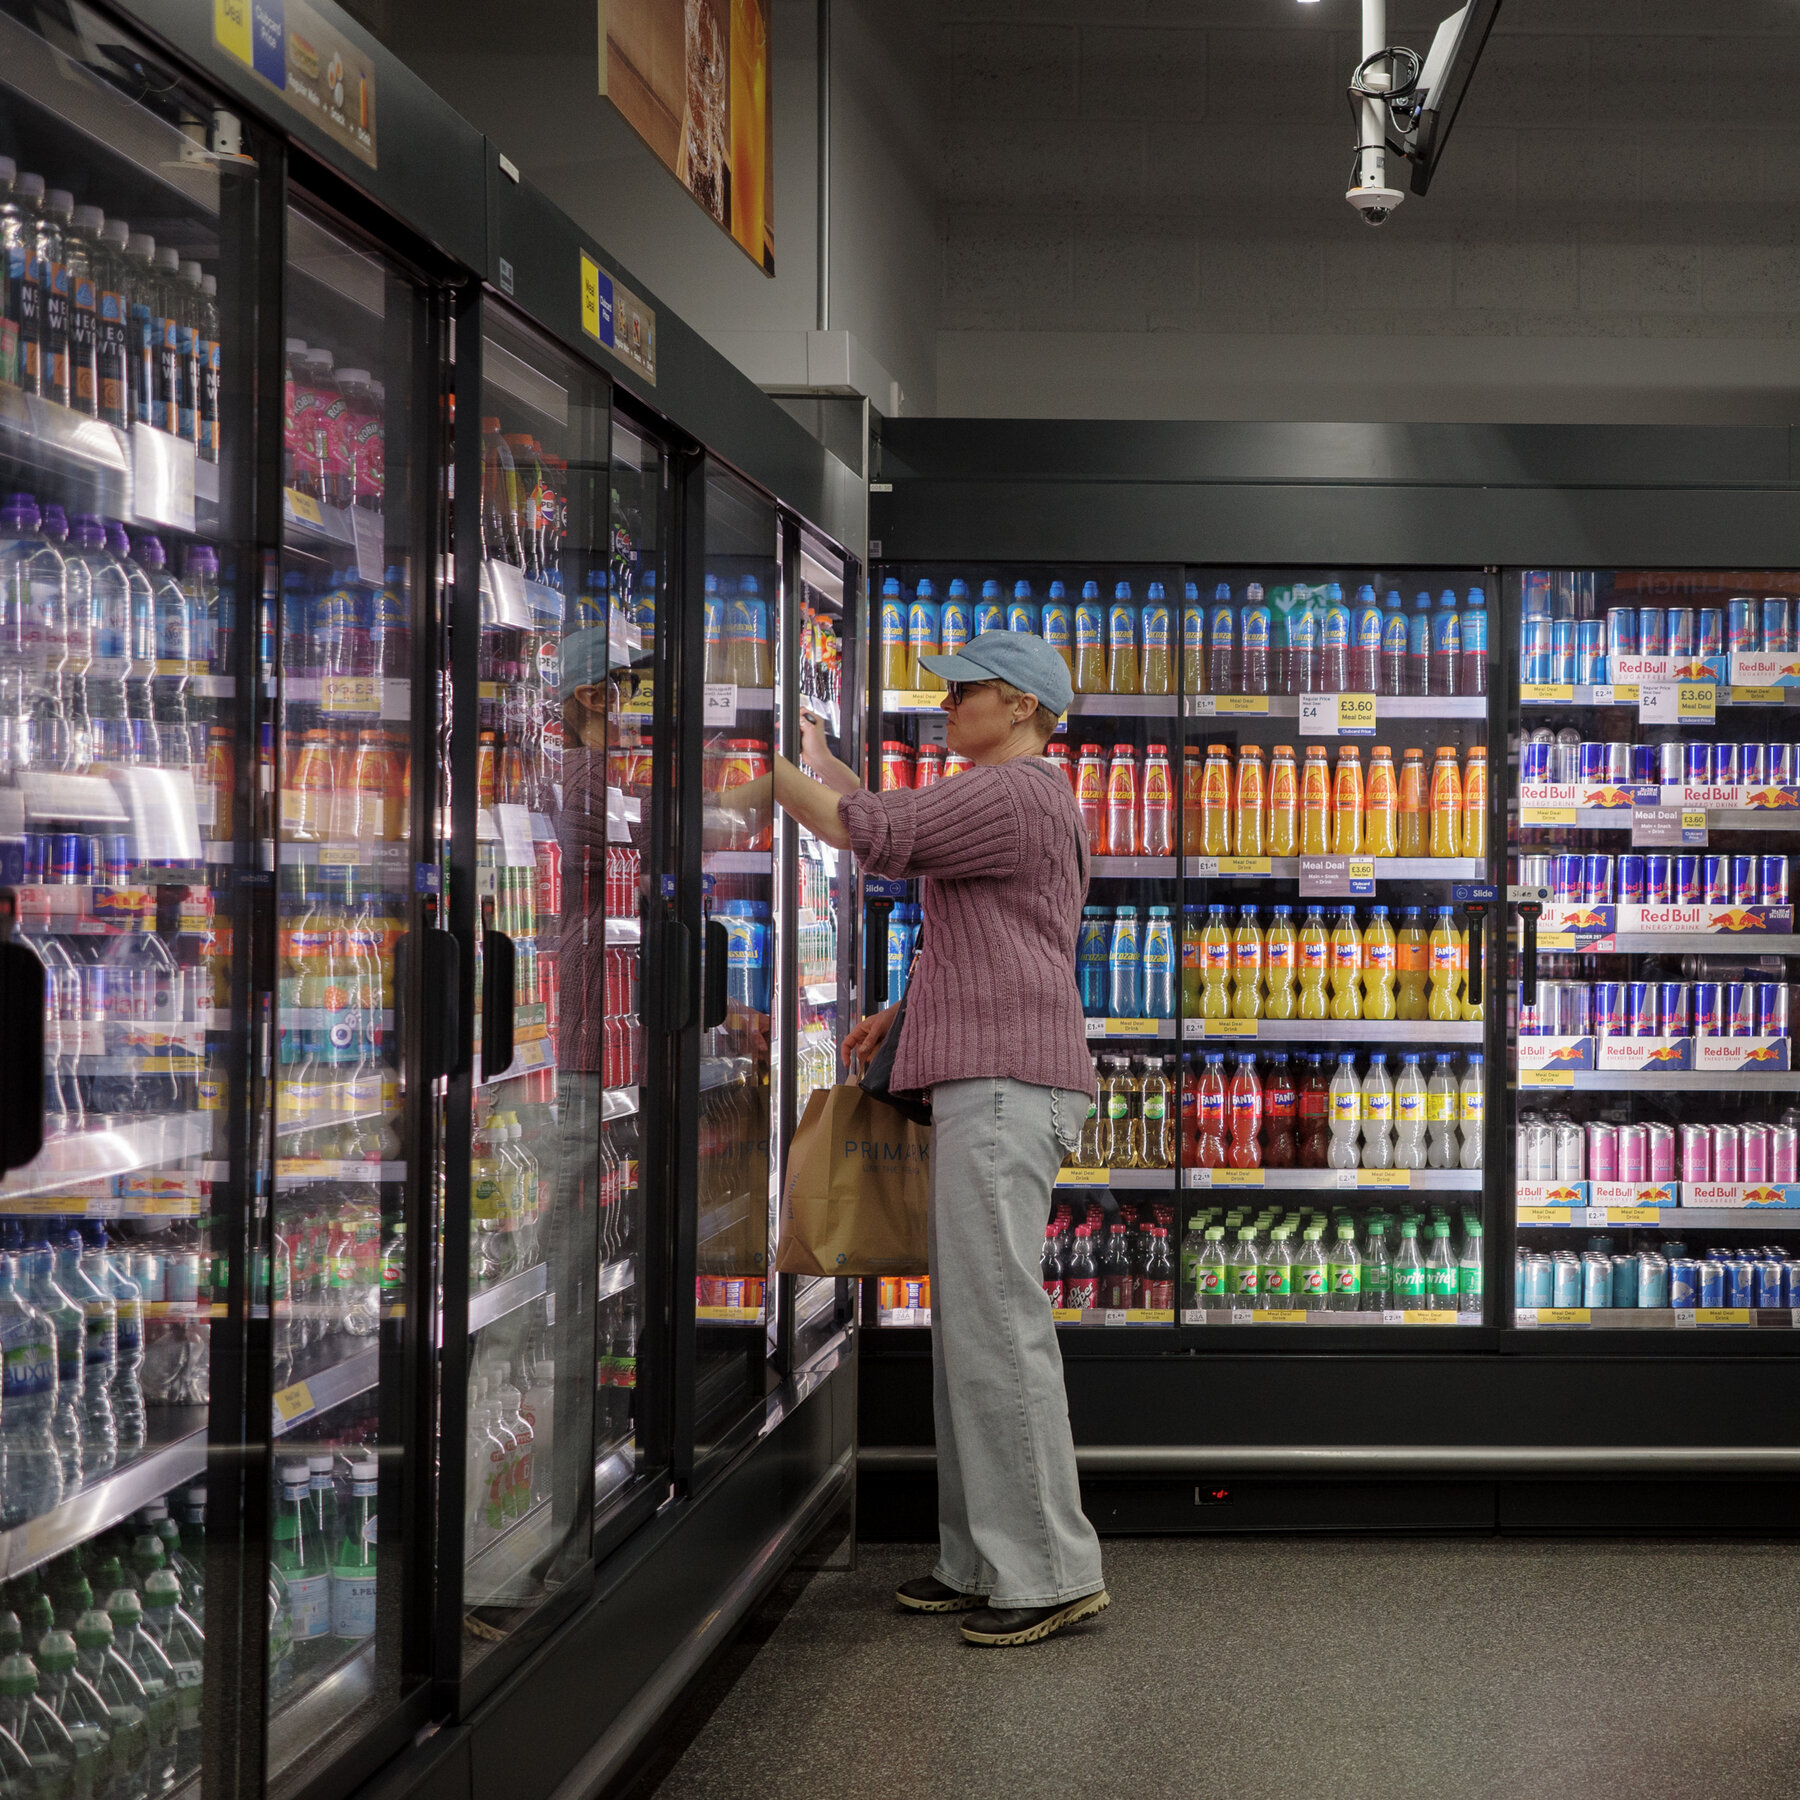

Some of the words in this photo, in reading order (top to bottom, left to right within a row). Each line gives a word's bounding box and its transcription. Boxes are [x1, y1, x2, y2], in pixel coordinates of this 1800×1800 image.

[22, 286, 38, 303] NE
[23, 302, 39, 319] WT
[49, 298, 67, 313] NE
[50, 314, 67, 330] WT
[97, 324, 124, 342] EO
[162, 351, 176, 364] NE
[207, 373, 220, 388] NE
[1620, 661, 1642, 673] Red
[1644, 661, 1667, 673] Bull
[1739, 662, 1756, 671] Red
[1758, 662, 1776, 671] Bull
[1643, 696, 1657, 706] £4
[1681, 690, 1713, 701] £3.60
[1303, 707, 1317, 717] £4
[1340, 701, 1373, 712] £3.60
[1522, 786, 1548, 799] Red
[1550, 786, 1576, 799] Bull
[1684, 787, 1711, 801] Red
[1713, 787, 1738, 801] Bull
[1635, 811, 1657, 820] Meal
[1658, 811, 1678, 820] Deal
[1302, 861, 1323, 870] Meal
[1325, 861, 1345, 870] Deal
[1351, 866, 1371, 874] £3.60
[1561, 882, 1576, 890] Red
[1586, 882, 1601, 890] Red
[1473, 890, 1493, 898] Slide
[1540, 909, 1554, 921] ull
[1641, 909, 1669, 922] Red
[1672, 908, 1700, 922] Bull
[1528, 1047, 1545, 1055] Bull
[1607, 1046, 1625, 1055] Red
[1626, 1046, 1644, 1055] Bull
[1704, 1047, 1722, 1056] Red
[1723, 1047, 1741, 1056] Bull
[1525, 1187, 1542, 1196] Bull
[1596, 1187, 1614, 1196] Red
[1615, 1187, 1633, 1197] Bull
[1695, 1187, 1715, 1198] Red
[1717, 1187, 1737, 1198] Bull
[1394, 1271, 1425, 1286] Sprite
